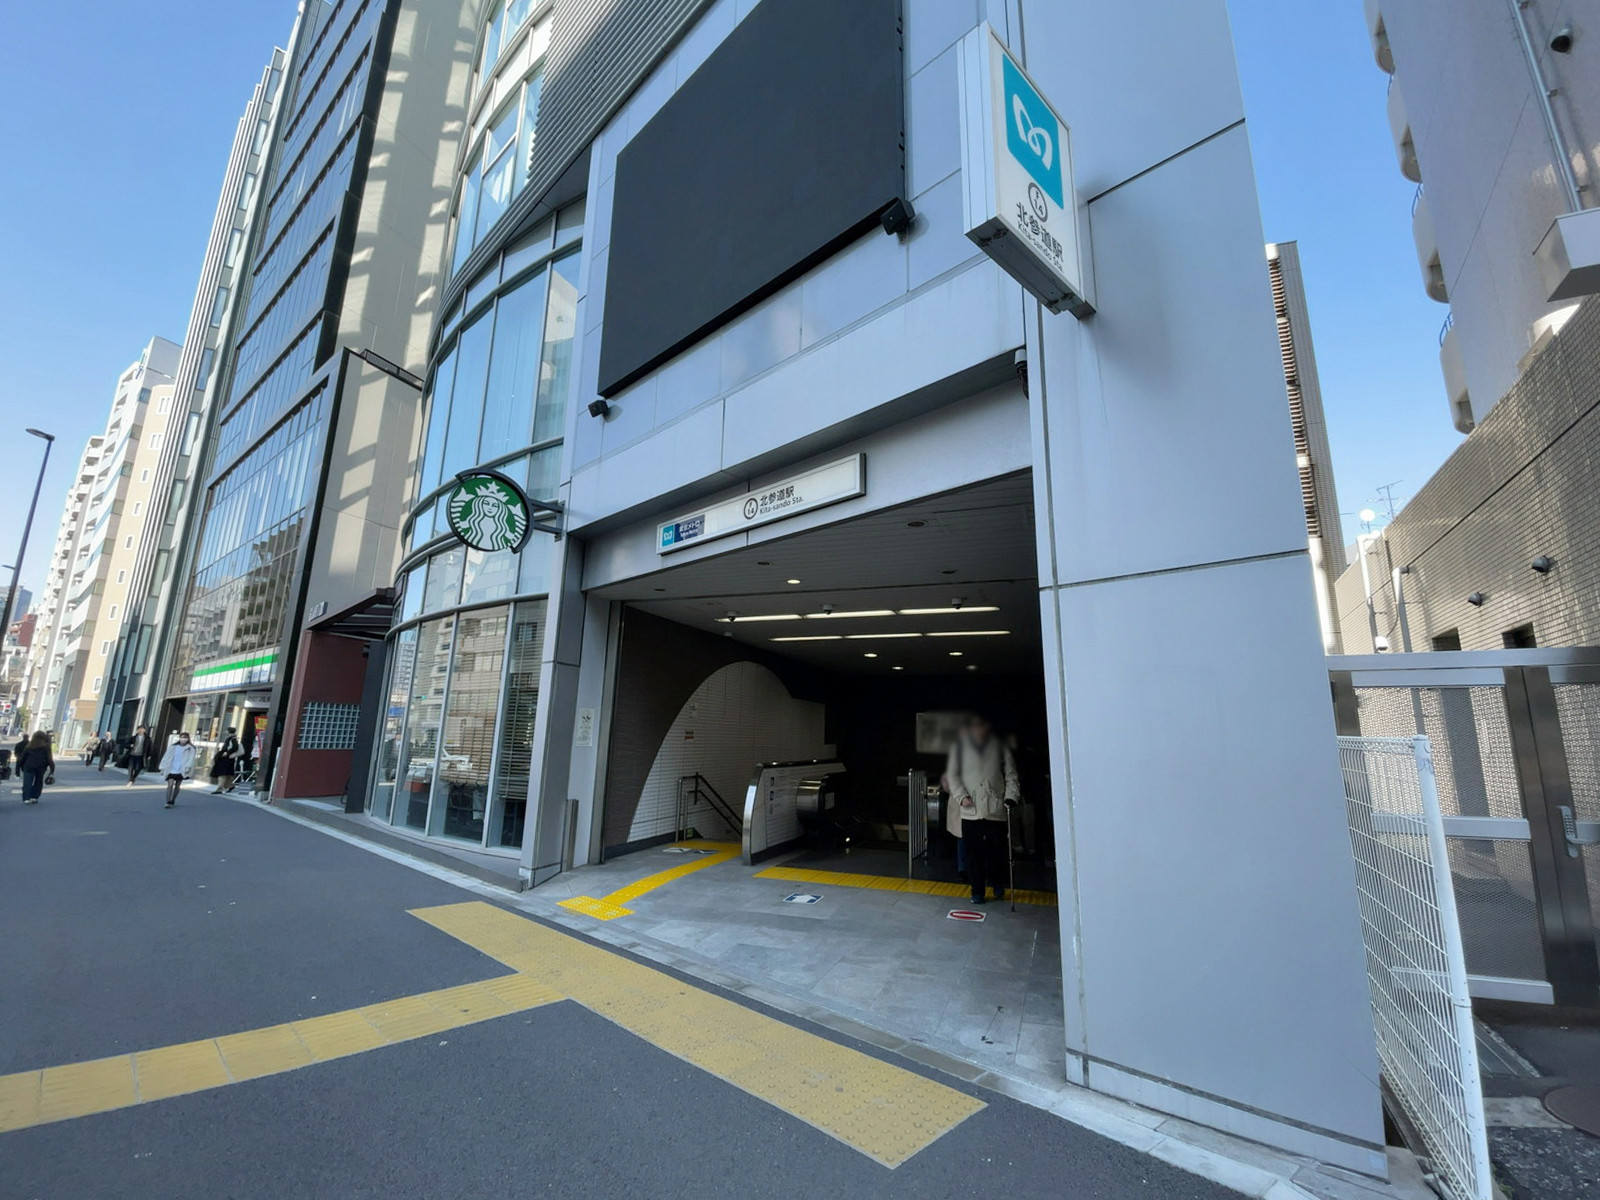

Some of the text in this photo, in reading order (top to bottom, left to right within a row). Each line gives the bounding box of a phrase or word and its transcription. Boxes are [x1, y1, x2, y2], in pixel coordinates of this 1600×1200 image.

[1034, 199, 1044, 215] 14
[1016, 202, 1064, 263] 北参道駅
[760, 486, 794, 506] 北参道駅
[760, 500, 791, 514] Kita-sando
